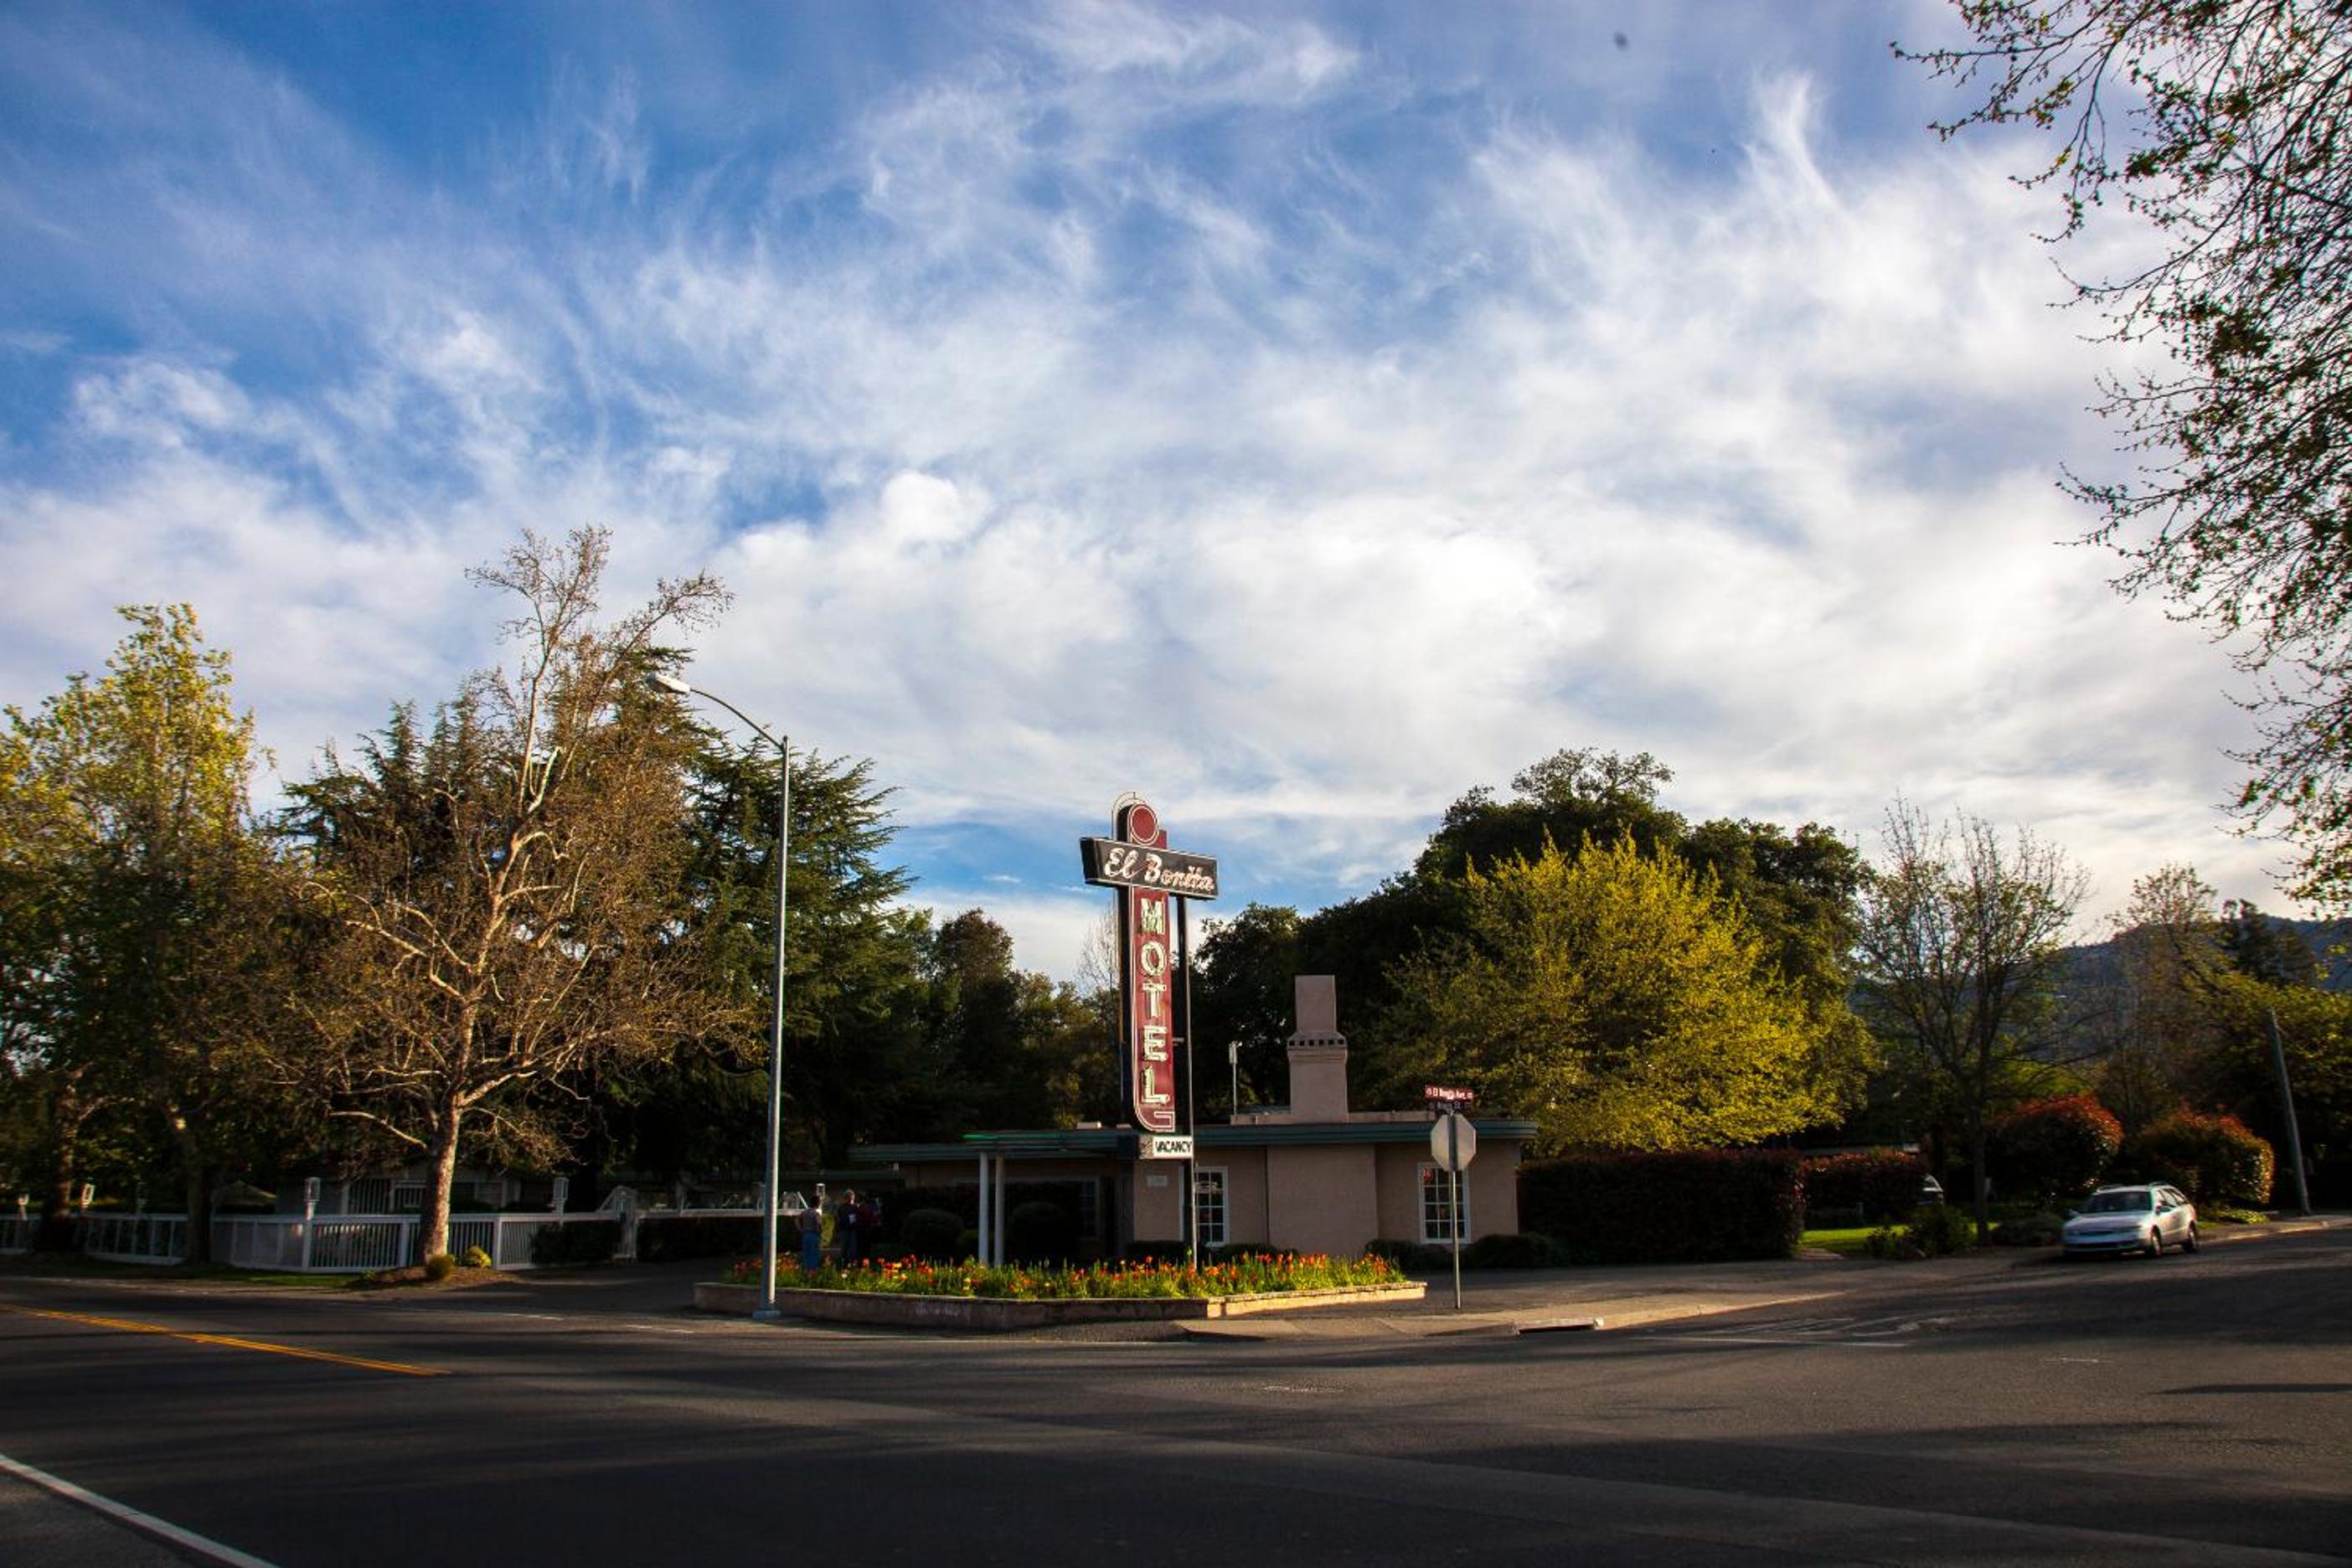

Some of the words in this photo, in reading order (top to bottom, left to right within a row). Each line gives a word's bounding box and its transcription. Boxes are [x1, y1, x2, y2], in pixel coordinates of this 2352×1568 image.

[1104, 847, 1139, 879] El
[1143, 852, 1215, 891] Bonita
[1140, 898, 1171, 1104] MOTEL
[1155, 1140, 1193, 1153] VACANCY
